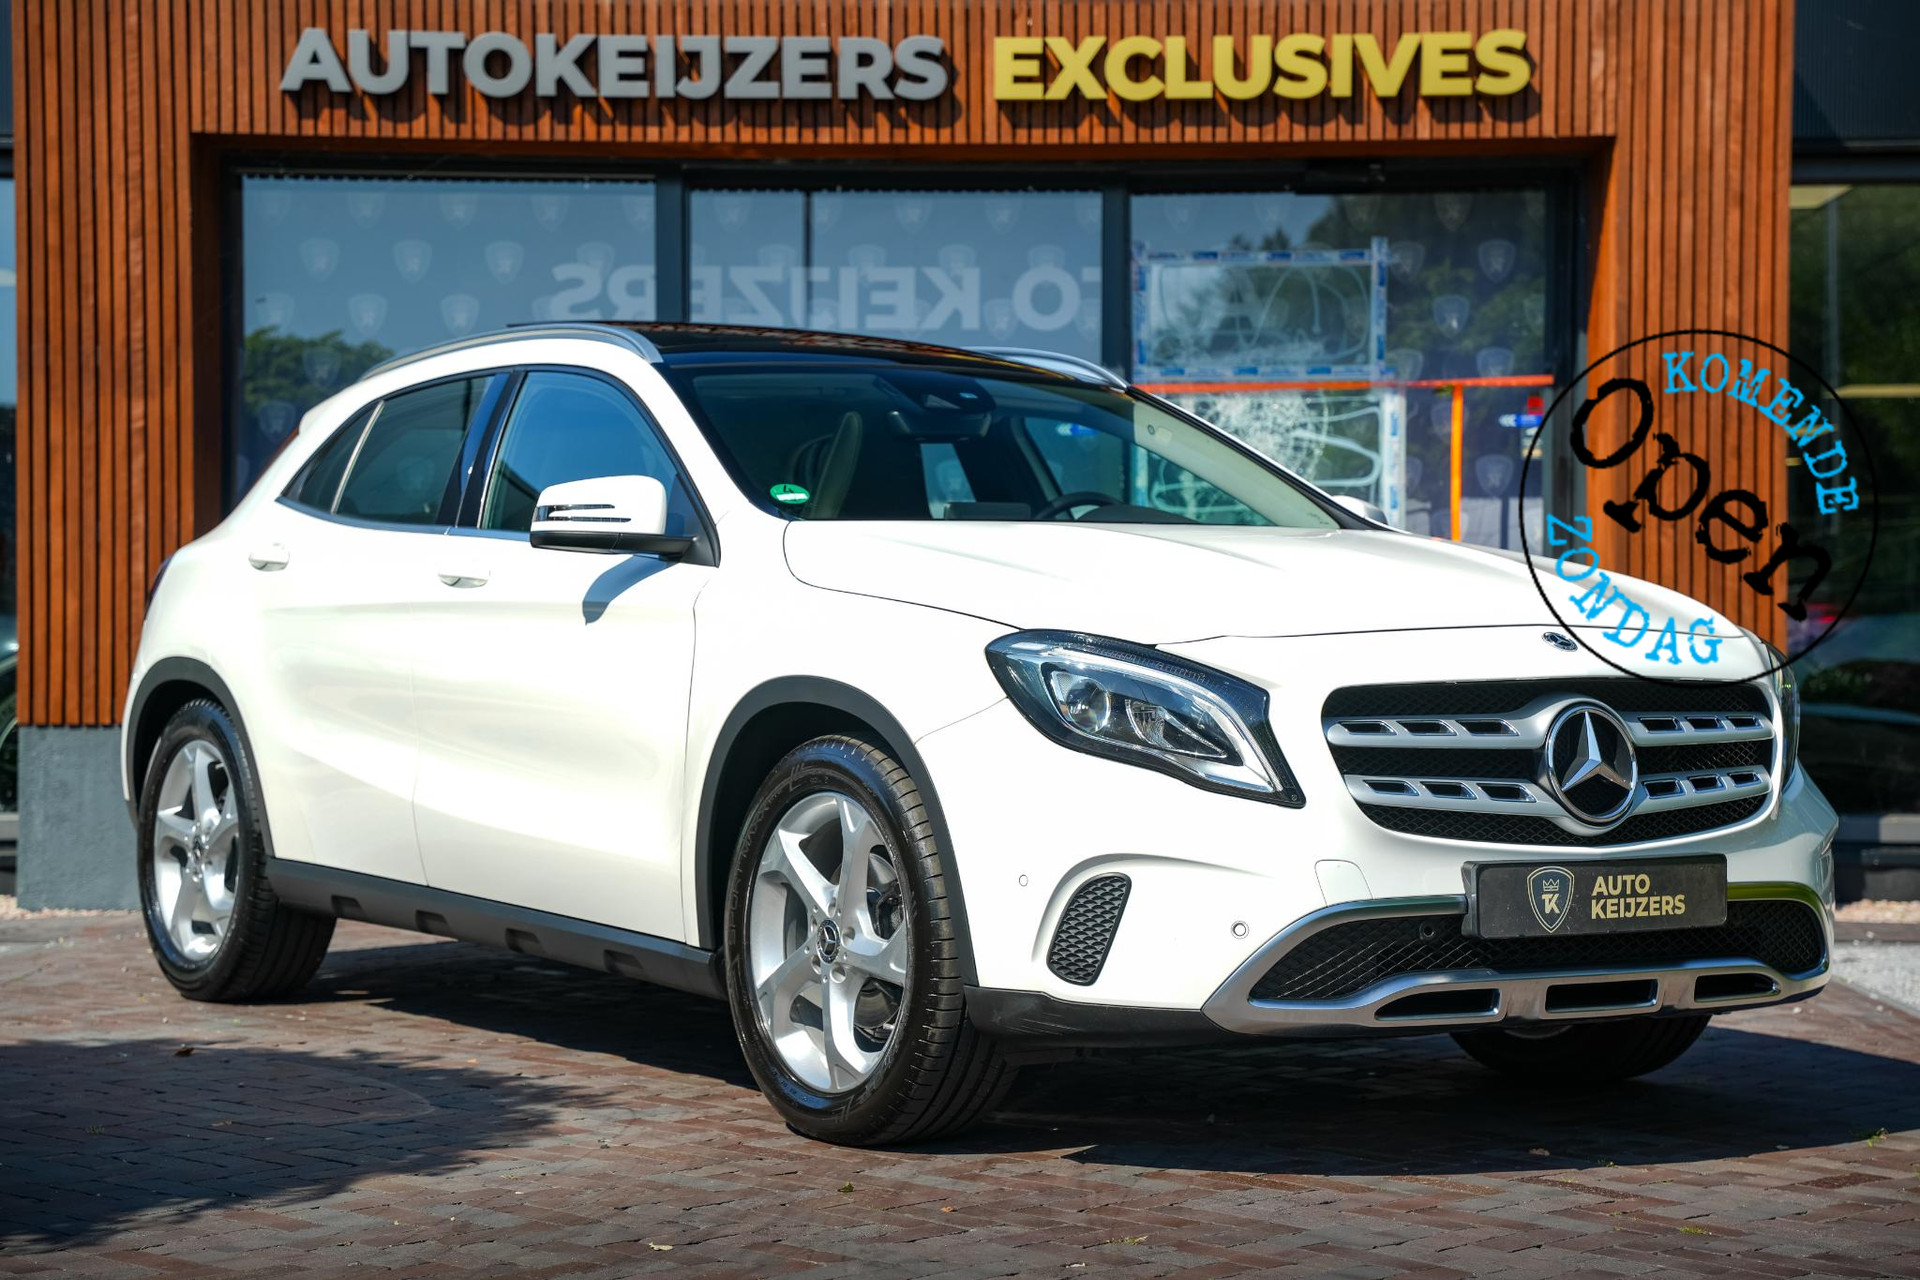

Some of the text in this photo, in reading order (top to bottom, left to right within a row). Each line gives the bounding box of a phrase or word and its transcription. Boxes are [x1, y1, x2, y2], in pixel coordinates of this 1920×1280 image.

[280, 27, 1532, 100] AUTOKEIJZERS EXCLUSIVES
[1592, 874, 1650, 896] AUTO
[1592, 895, 1686, 919] KEIJZERS
